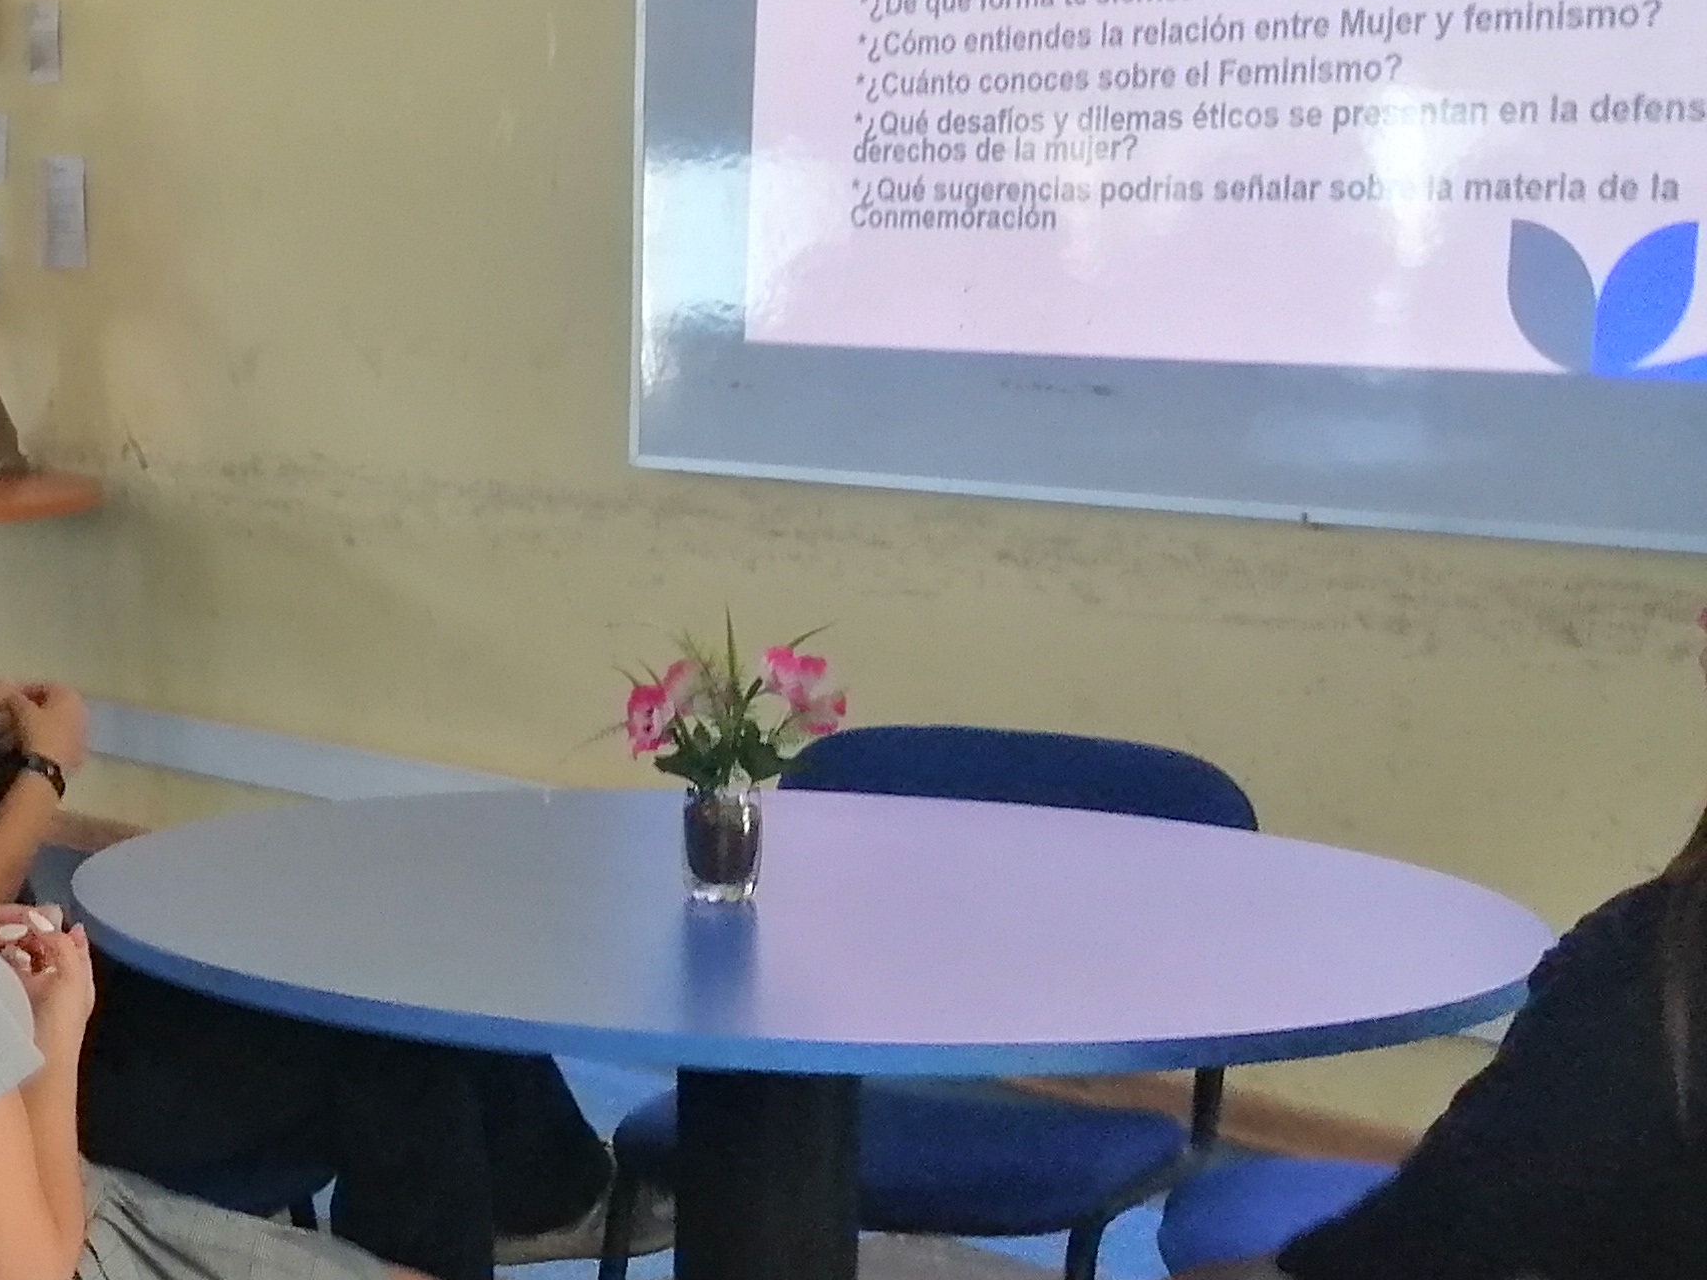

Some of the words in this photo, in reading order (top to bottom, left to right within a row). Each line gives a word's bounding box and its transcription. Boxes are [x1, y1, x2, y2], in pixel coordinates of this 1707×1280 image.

[964, 22, 1092, 53] entiendes
[1100, 20, 1123, 48] la
[1132, 13, 1245, 47] relación
[1254, 10, 1330, 41] entre
[1340, 5, 1426, 43] Mujer
[1435, 11, 1454, 41] y
[979, 70, 1089, 94] conoces
[1097, 62, 1176, 90] sobre
[1185, 59, 1209, 88] el
[1219, 52, 1403, 87] Feminismo?
[936, 105, 1045, 135] desafíos
[1053, 112, 1069, 139] y
[1077, 104, 1183, 132] dilemas
[1192, 101, 1280, 130] éticos
[1289, 105, 1322, 129] se
[1498, 101, 1538, 125] en
[1550, 93, 1577, 124] la
[853, 136, 967, 163] derechos
[976, 137, 1006, 163] de
[1014, 137, 1036, 162] la
[1044, 133, 1138, 168] mujer?
[933, 174, 1091, 211] sugerencias
[1100, 173, 1204, 210] podrías
[1214, 172, 1323, 202] señalar
[1427, 175, 1453, 202] la
[1464, 172, 1587, 202] materia
[1597, 172, 1638, 203] de
[1651, 171, 1680, 202] la
[850, 204, 1057, 230] Conmemoración
